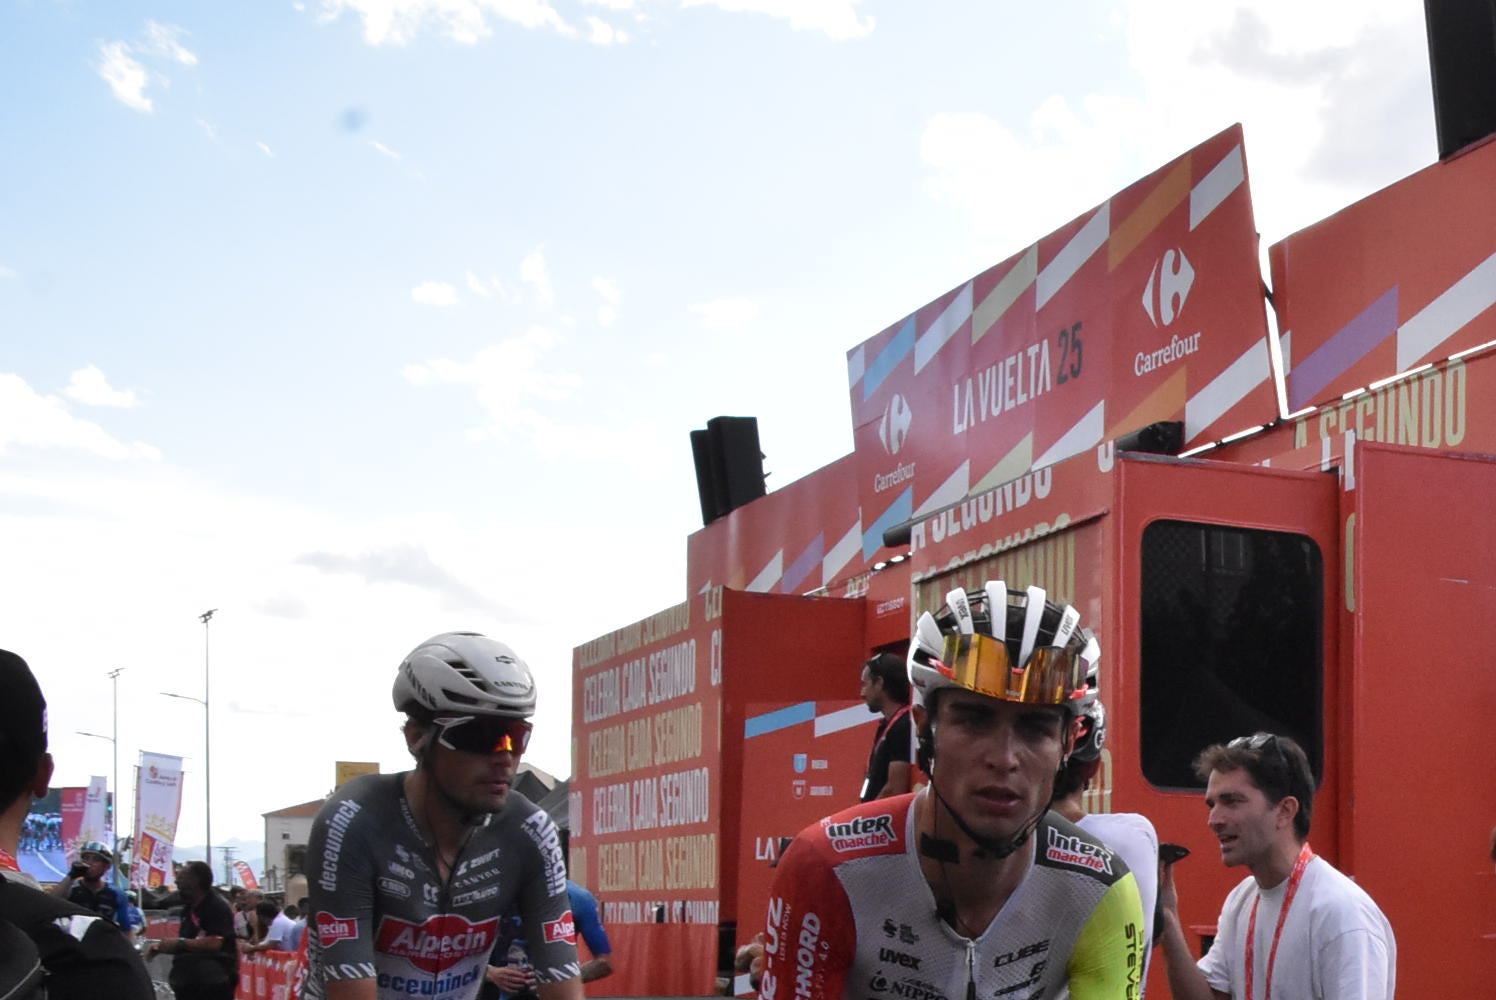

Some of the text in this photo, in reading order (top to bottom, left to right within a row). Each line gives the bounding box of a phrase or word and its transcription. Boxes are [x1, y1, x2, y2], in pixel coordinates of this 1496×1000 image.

[953, 322, 1083, 435] LA VUELTA 25
[1135, 331, 1201, 376] Carrefour
[874, 461, 916, 493] Carrefour
[649, 638, 696, 705] SEGUNDO
[660, 767, 709, 827] SEGUNDO
[318, 799, 362, 892] deceuninck
[526, 809, 567, 893] Alpecin
[391, 927, 487, 954] Alpecin
[879, 948, 922, 970] uvex
[994, 940, 1049, 967] CUBE
